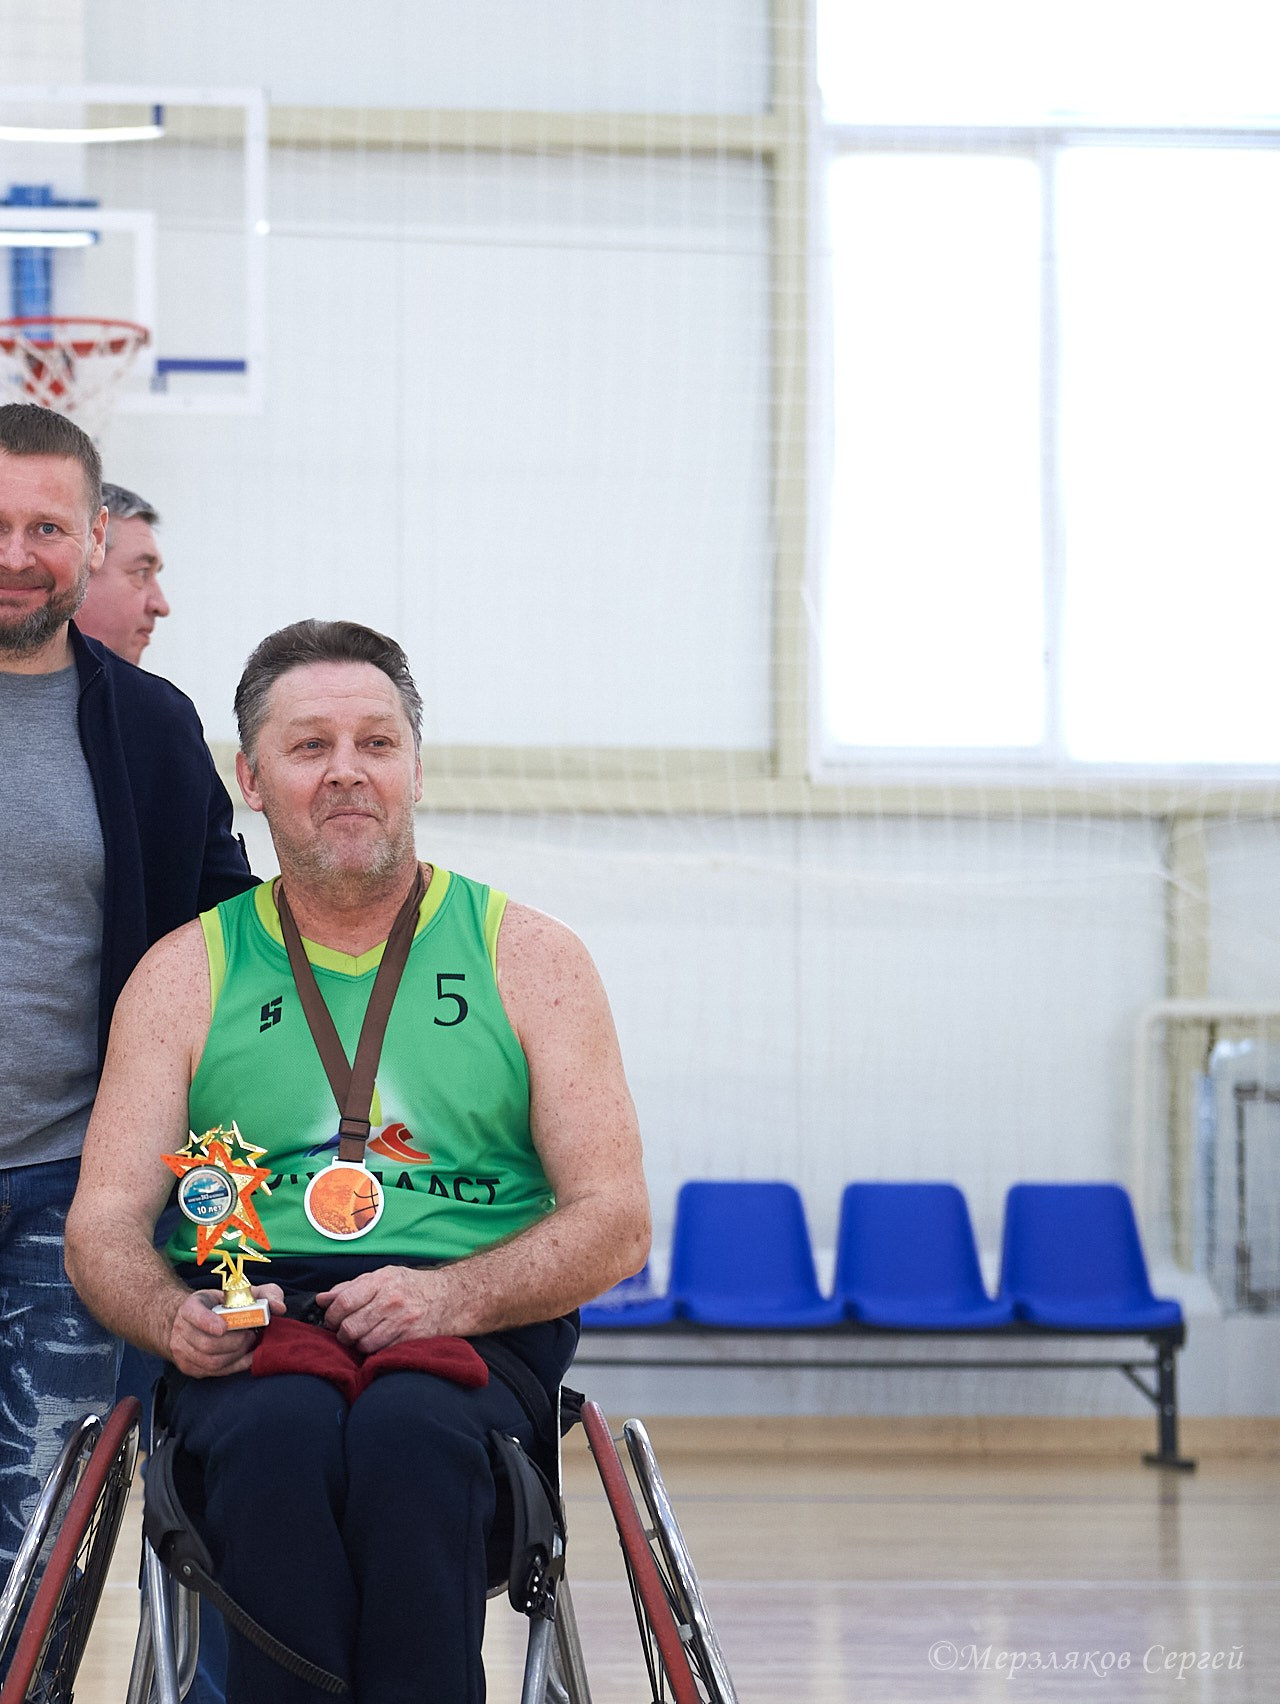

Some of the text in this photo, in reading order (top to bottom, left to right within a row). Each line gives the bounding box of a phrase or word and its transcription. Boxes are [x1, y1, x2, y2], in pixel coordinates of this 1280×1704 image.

[433, 973, 468, 1027] 5
[197, 1205, 222, 1215] 10 лет
